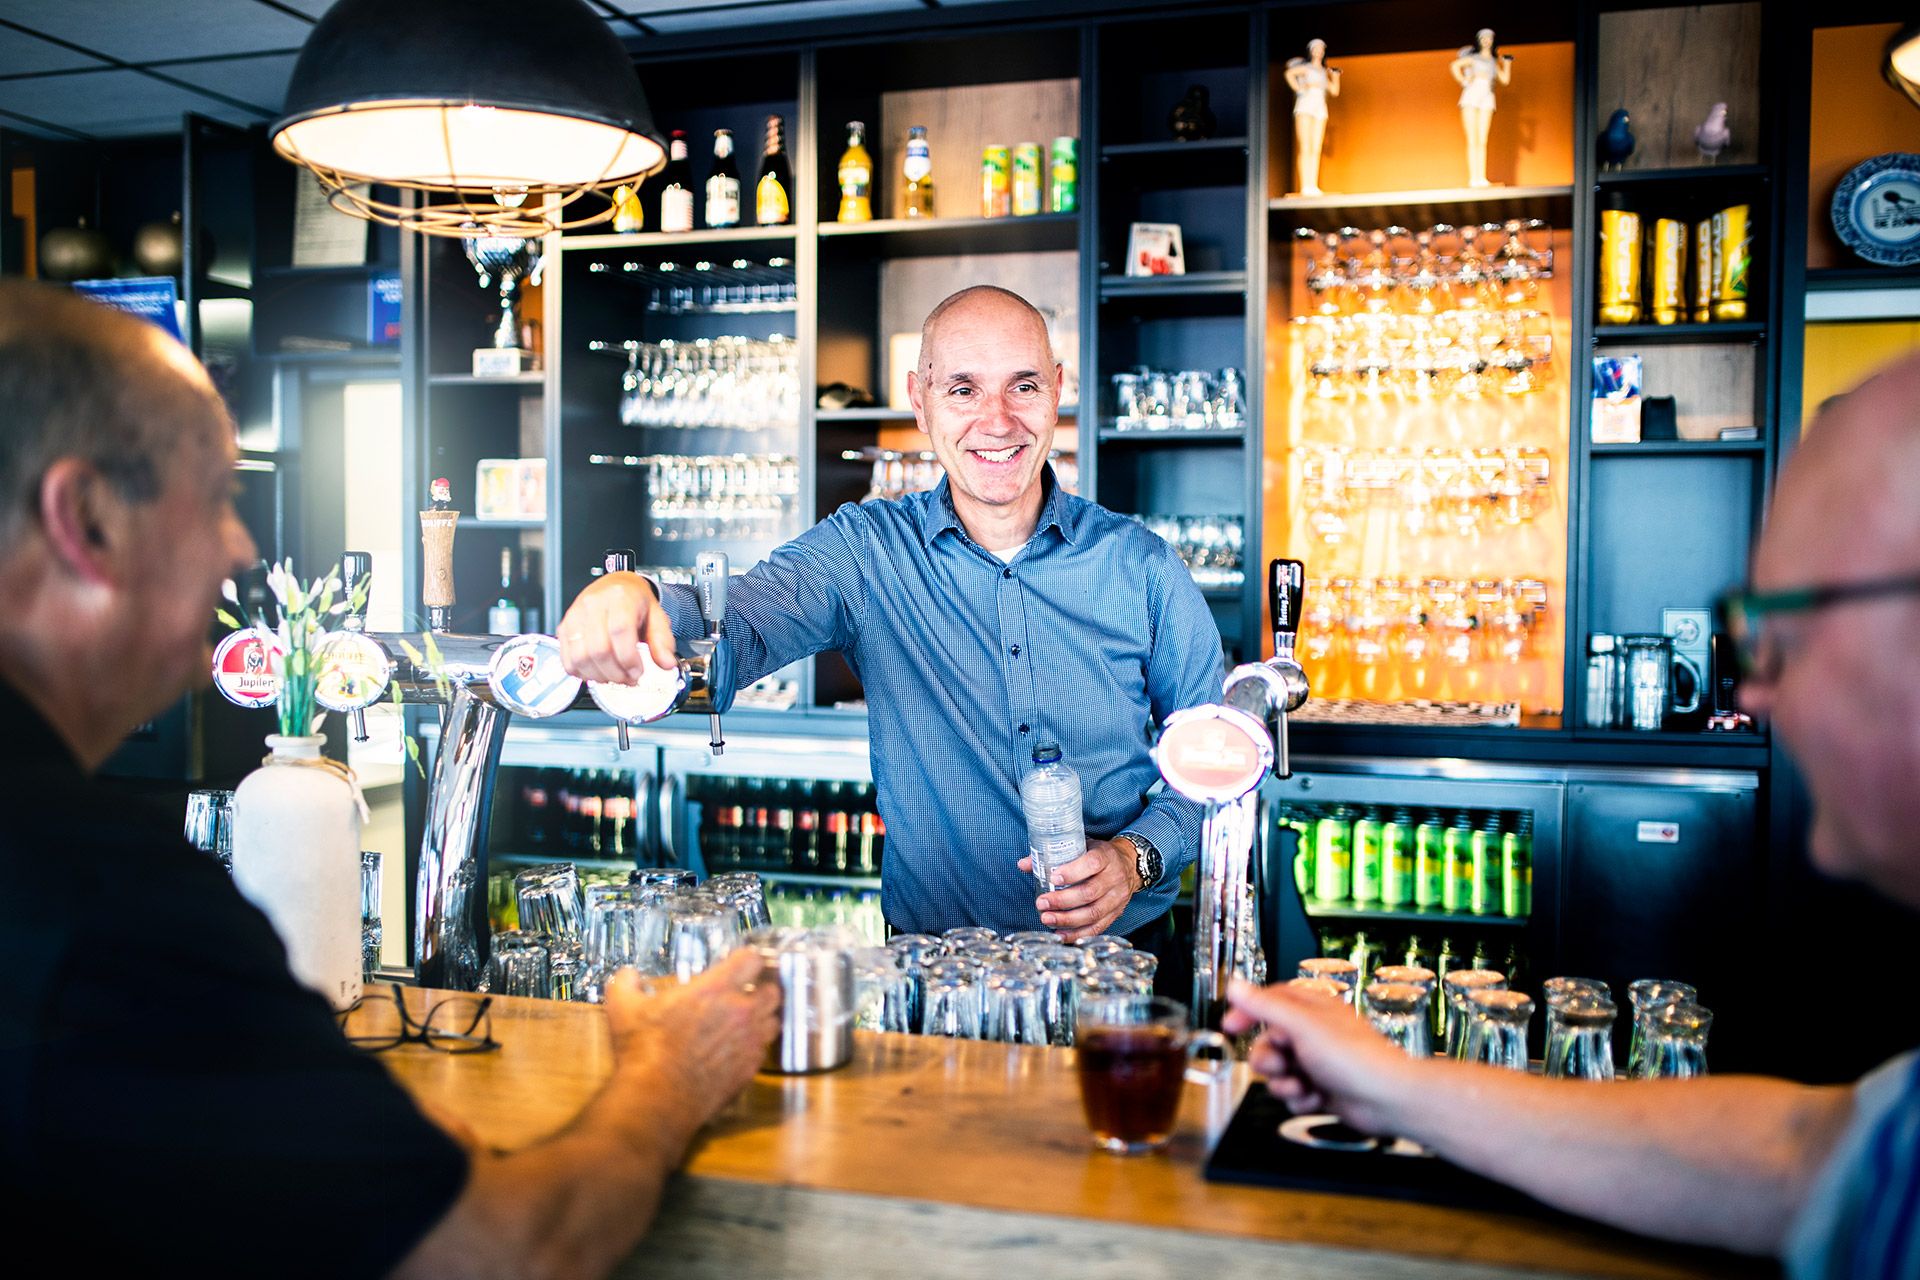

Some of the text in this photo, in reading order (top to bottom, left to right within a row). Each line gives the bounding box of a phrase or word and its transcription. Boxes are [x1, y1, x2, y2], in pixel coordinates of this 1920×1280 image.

[1618, 215, 1630, 300] HEAD
[1667, 222, 1679, 305] HEAD
[1700, 223, 1711, 304] HEAD
[1712, 214, 1722, 299] HEAD
[239, 676, 274, 688] Jupiler
